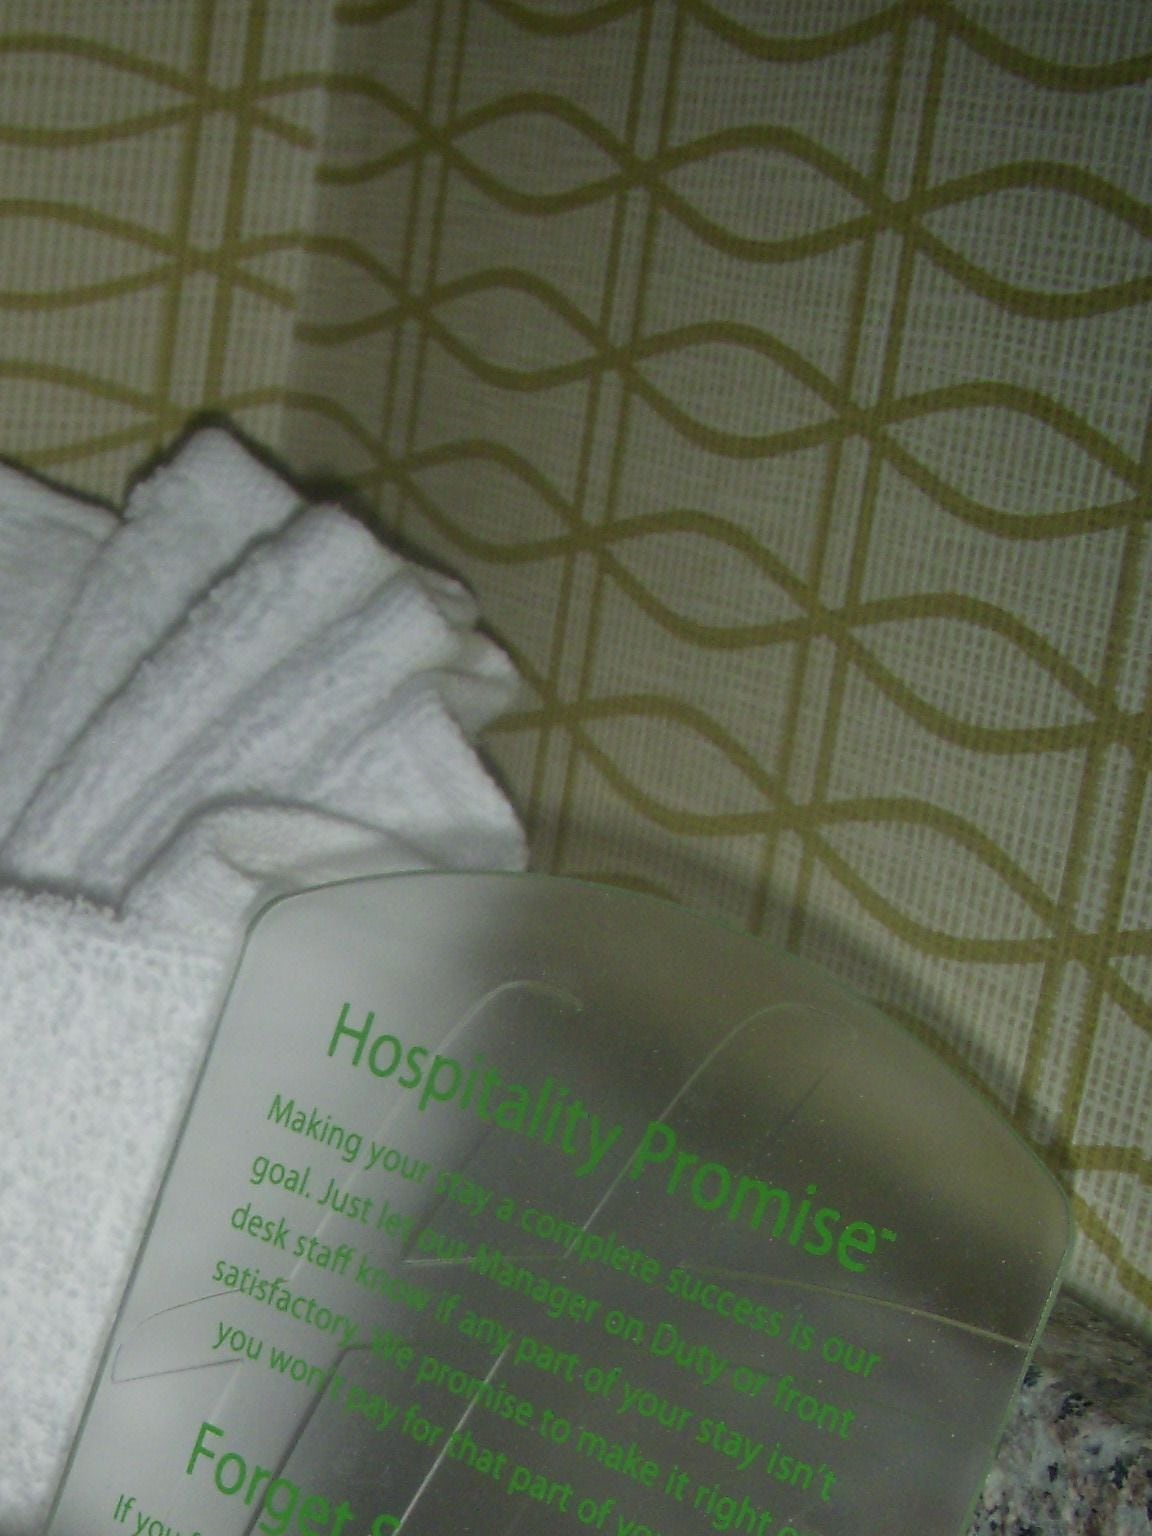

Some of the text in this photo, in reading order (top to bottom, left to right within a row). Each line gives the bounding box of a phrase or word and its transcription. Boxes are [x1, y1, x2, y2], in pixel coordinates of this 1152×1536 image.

[326, 1002, 624, 1178] Hospitality
[250, 1155, 856, 1440] goal. Just let our Manager on Duty or front
[266, 1093, 882, 1378] Making your stay a complete success is our
[212, 1321, 264, 1361] you
[345, 1384, 399, 1432] pay
[401, 1403, 445, 1446] for
[446, 1430, 508, 1483] that
[507, 1465, 574, 1513] part
[576, 1498, 617, 1530] of
[231, 1202, 838, 1502] desk staff know if any part of your stay isn't
[415, 1356, 534, 1427] promise
[538, 1408, 571, 1445] to
[574, 1430, 661, 1486] make
[664, 1464, 690, 1502] it
[112, 1493, 137, 1523] If
